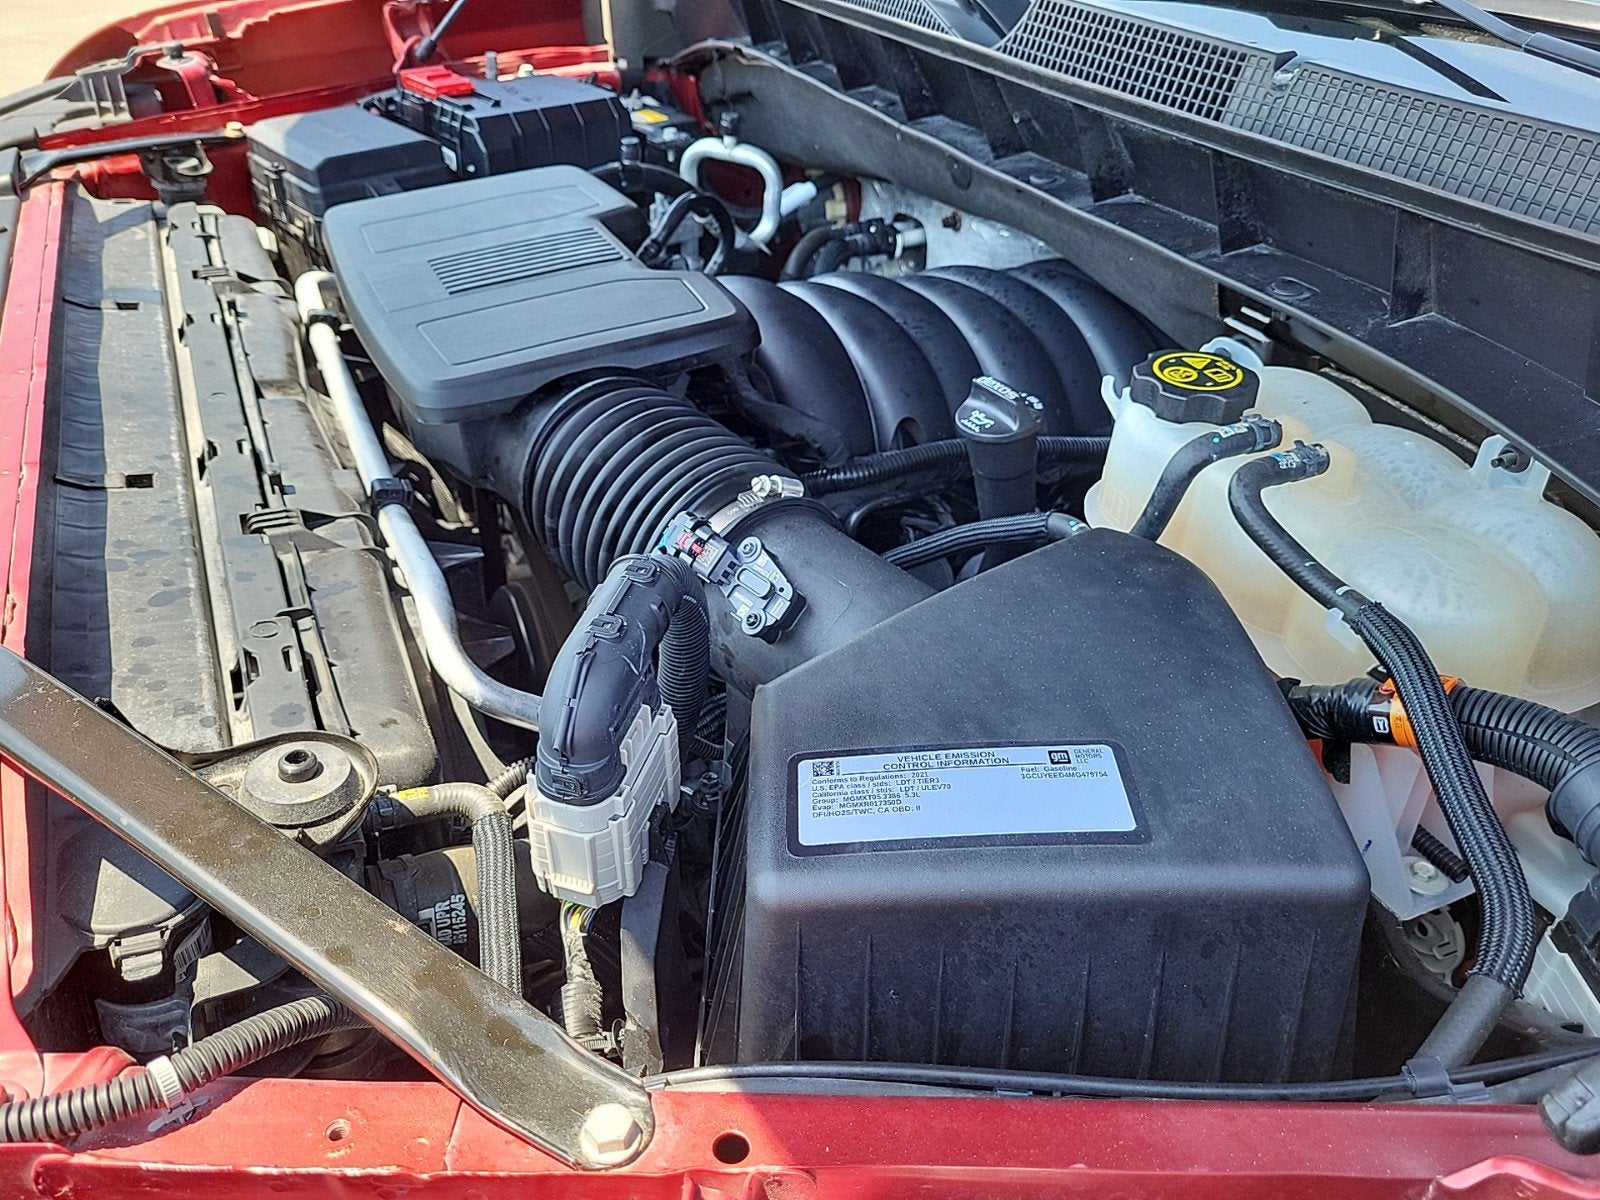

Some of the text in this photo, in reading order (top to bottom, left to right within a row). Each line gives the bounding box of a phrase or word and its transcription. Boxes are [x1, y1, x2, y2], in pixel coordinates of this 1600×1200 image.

[897, 751, 996, 763] VEHICLE EMISSION
[883, 757, 1010, 770] CONTROL INFORMATION
[812, 777, 848, 785] Conforms
[859, 773, 907, 783] Regulations:
[846, 782, 866, 790] class
[896, 778, 911, 786] LDT
[812, 790, 849, 799] California
[850, 788, 870, 796] class
[876, 786, 895, 794] stds:
[812, 804, 834, 812] Evap:
[434, 900, 451, 928] UPR
